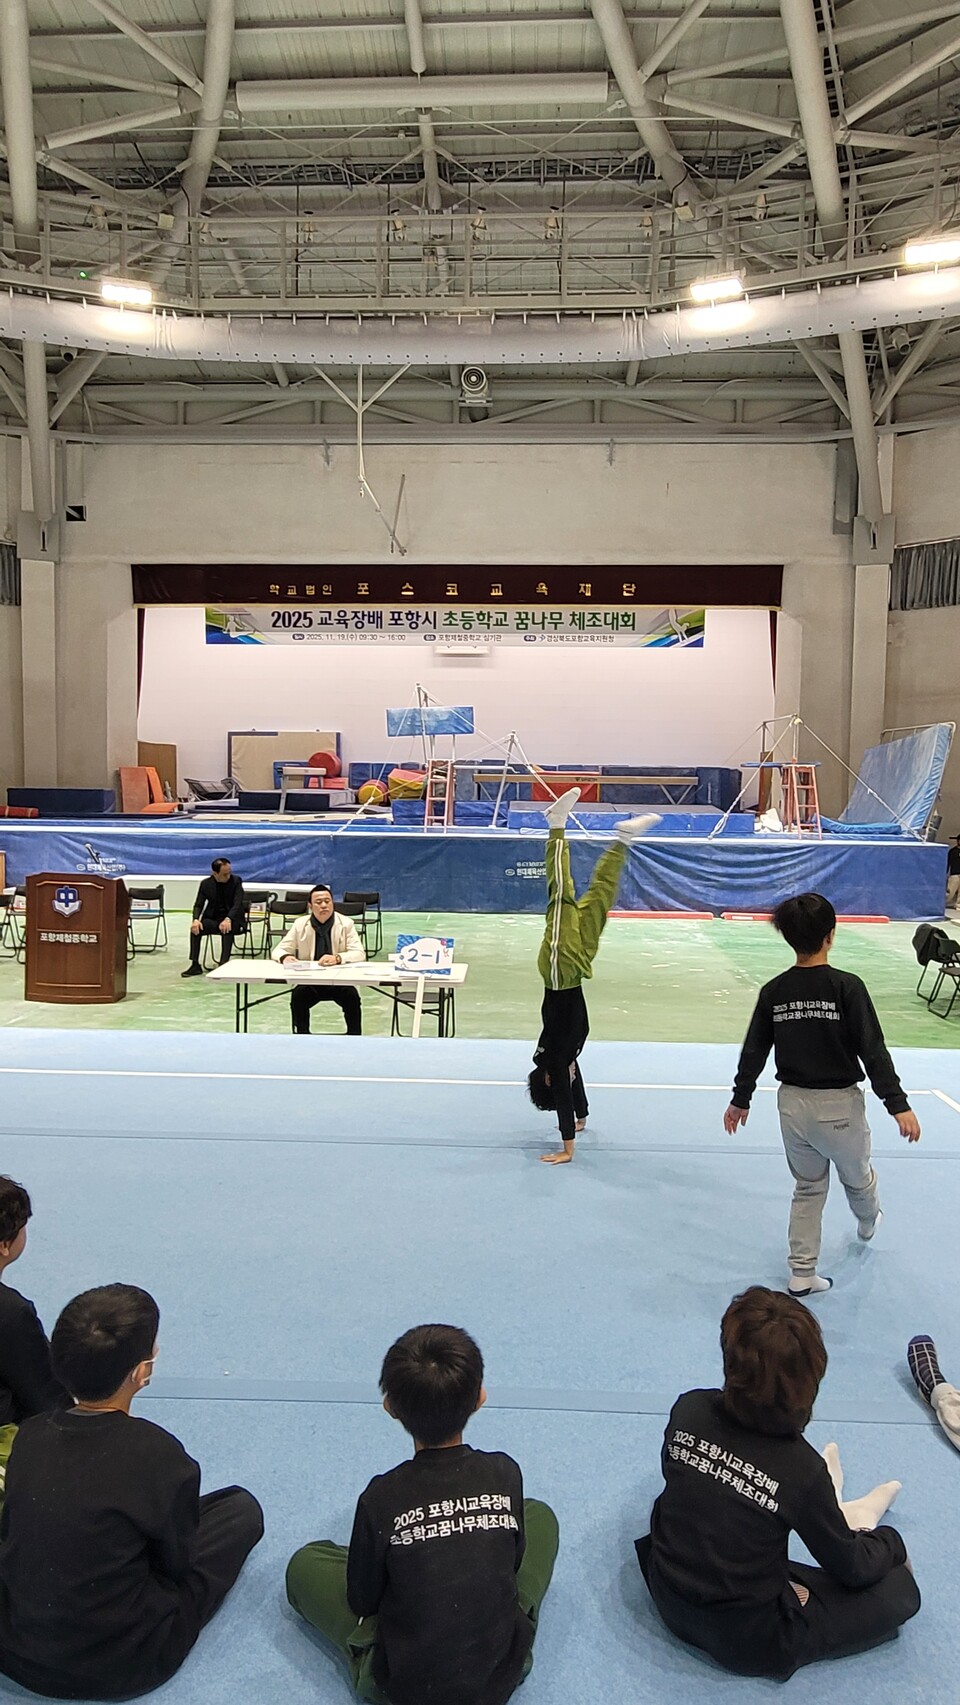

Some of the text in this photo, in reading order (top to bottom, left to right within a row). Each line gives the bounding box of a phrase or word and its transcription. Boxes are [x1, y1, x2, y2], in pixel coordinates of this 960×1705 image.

[271, 609, 636, 631] 2025 교육장배 포항시 초등학교 꿈나무 체조대회
[359, 633, 378, 641] 09:30
[40, 932, 98, 944] 포항제철중학교
[407, 948, 440, 965] 2-1
[672, 1430, 780, 1496] 2025 포항시교육장배
[393, 1494, 512, 1531] 2025 포항시교육장배
